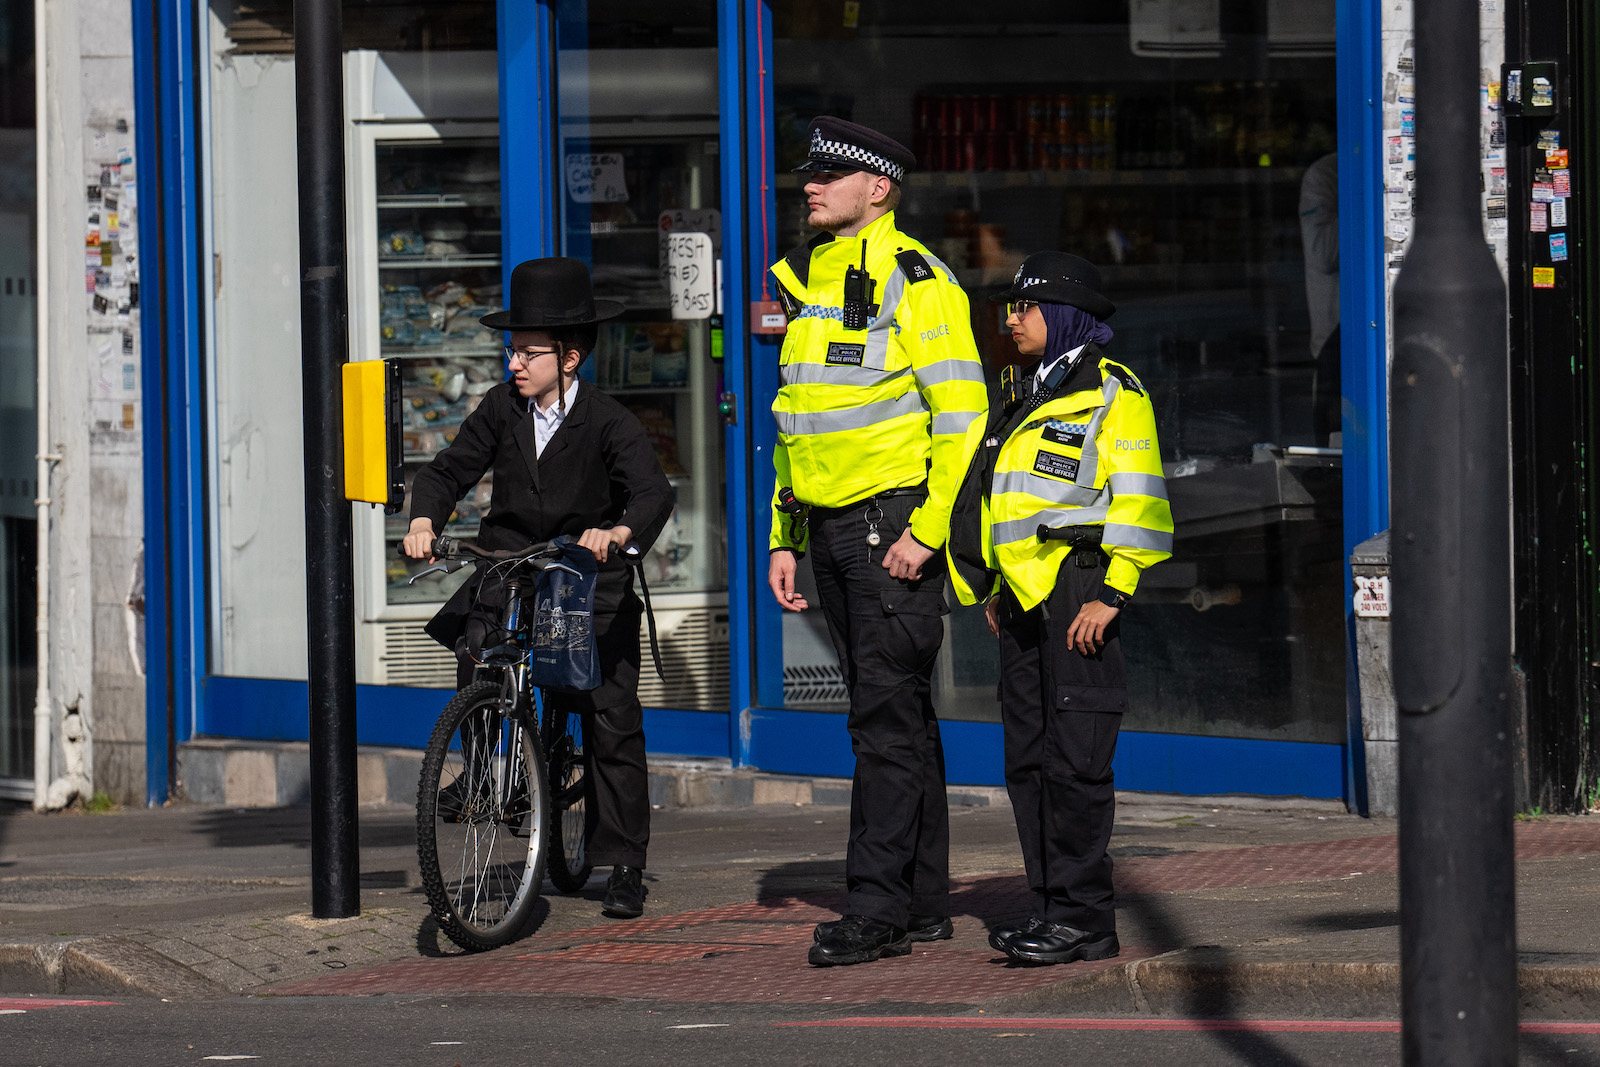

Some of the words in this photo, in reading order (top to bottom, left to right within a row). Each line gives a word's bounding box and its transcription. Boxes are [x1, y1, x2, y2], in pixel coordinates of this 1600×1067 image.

[920, 324, 950, 343] POLICE
[843, 356, 861, 364] OFFICER
[1115, 438, 1151, 451] POLICE
[1052, 462, 1072, 470] POLICE
[1036, 463, 1055, 473] POLICE
[1054, 468, 1075, 479] OFFICER
[1363, 593, 1384, 601] DANER
[1360, 603, 1370, 611] 240
[1371, 603, 1388, 611] VOLTS
